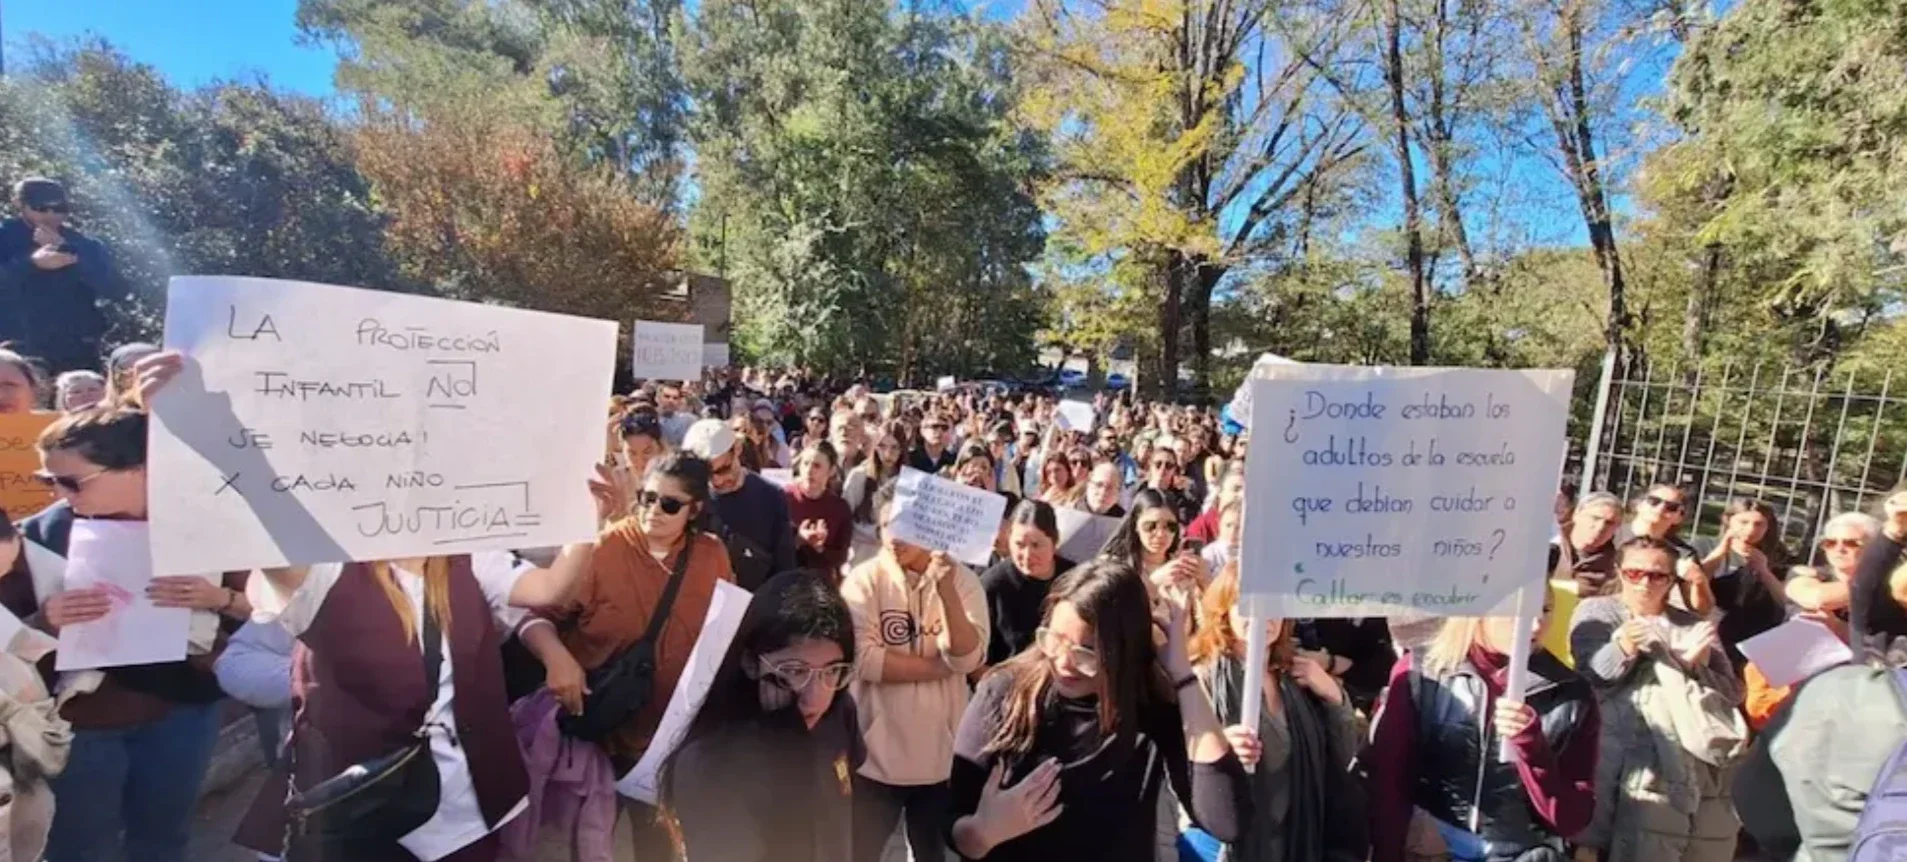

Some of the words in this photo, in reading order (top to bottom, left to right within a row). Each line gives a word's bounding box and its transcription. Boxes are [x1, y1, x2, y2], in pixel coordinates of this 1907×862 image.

[228, 304, 282, 340] LA
[254, 371, 401, 401] INFANTIL
[427, 371, 477, 398] NO
[1400, 393, 1475, 420] estaban
[1485, 392, 1512, 419] los
[228, 428, 273, 449] SE
[1302, 434, 1394, 467] adultos
[1402, 440, 1423, 467] de
[1428, 438, 1446, 467] la
[1456, 442, 1516, 467] escuela
[385, 470, 445, 489] NIÑO
[1292, 496, 1332, 526] que
[1430, 486, 1496, 512] cuidar
[1503, 497, 1517, 512] a
[1316, 533, 1402, 559] nuestros
